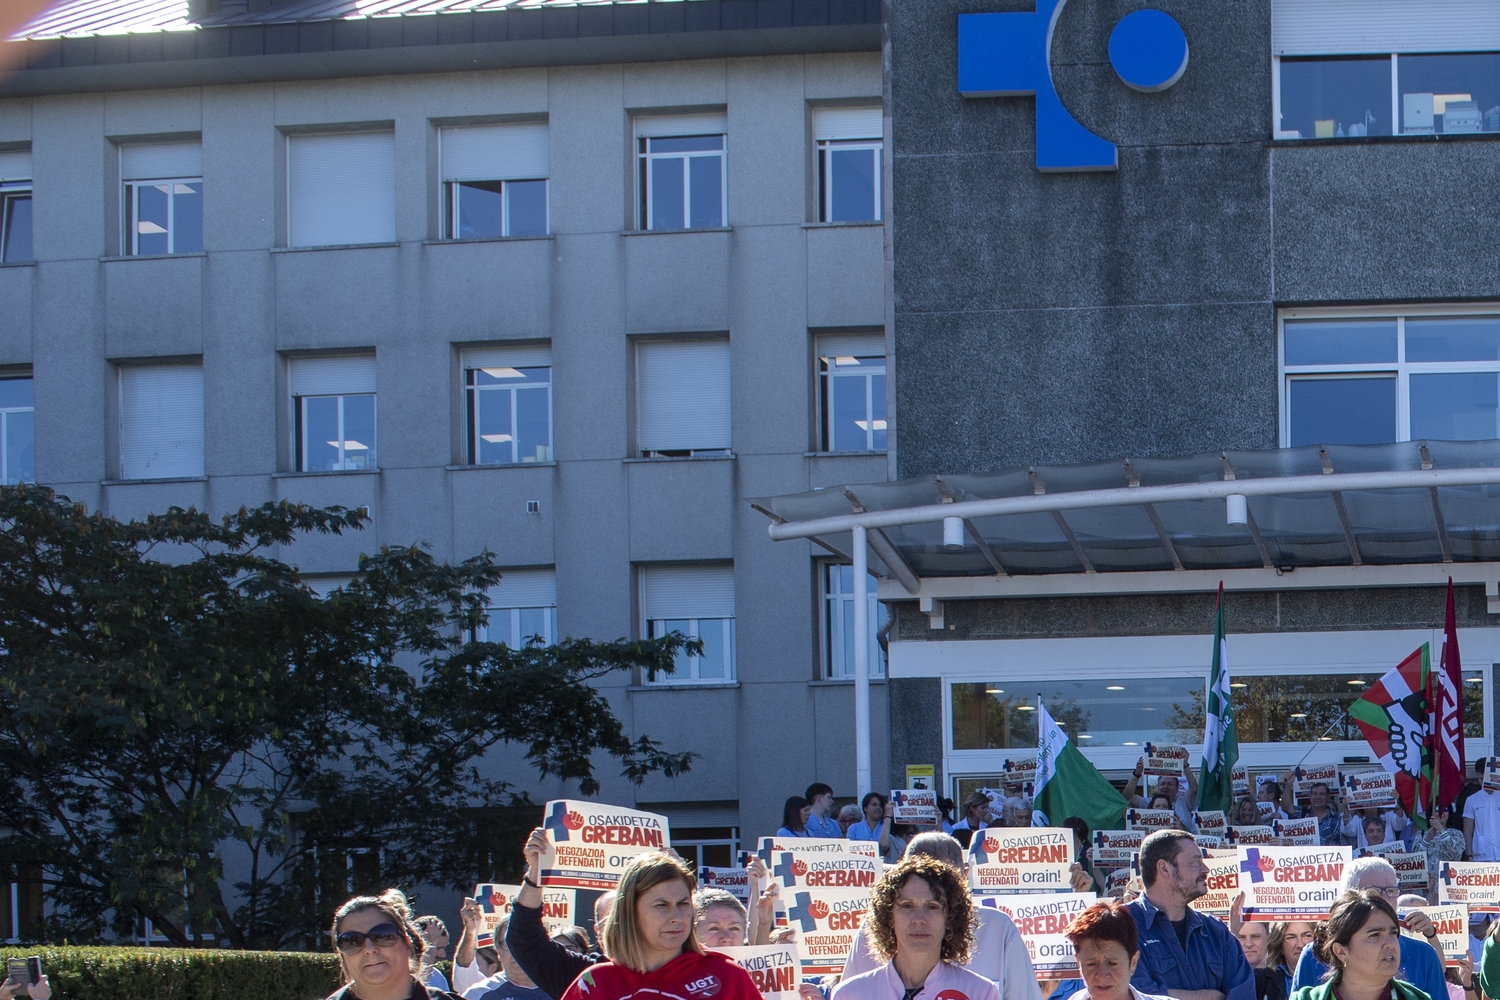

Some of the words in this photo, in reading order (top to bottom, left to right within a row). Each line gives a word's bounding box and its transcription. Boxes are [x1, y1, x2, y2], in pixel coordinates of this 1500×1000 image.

[1361, 779, 1392, 789] GREBAN!
[588, 815, 661, 829] OSAKIDETZA
[582, 825, 663, 848] GREBAN!
[1283, 825, 1316, 837] GREBAN!
[1002, 833, 1067, 849] OSAKIDETZA
[555, 846, 605, 859] NEGOZIAZIOA
[998, 844, 1068, 864] GREBAN!
[558, 856, 605, 869] DEFENDATU
[811, 860, 875, 871] OSAKIDETZA
[1278, 852, 1344, 868] OSAKIDETZA
[977, 868, 1019, 877] NEGOZIAZIOA
[980, 876, 1019, 886] DEFENDATU
[1022, 869, 1061, 883] orain!
[1274, 863, 1345, 883] GREBAN!
[1459, 867, 1500, 875] OSAKIDETZA
[806, 870, 876, 888] GREBAN!
[1456, 874, 1500, 887] GREBAN!
[1253, 886, 1295, 895] NEGOZIAZIOA
[1256, 895, 1295, 904] DEFENDATU
[1298, 888, 1338, 902] orain!
[1470, 890, 1495, 900] orain!
[804, 935, 853, 946] NEGOZIAZIOA
[684, 975, 714, 993] UGT
